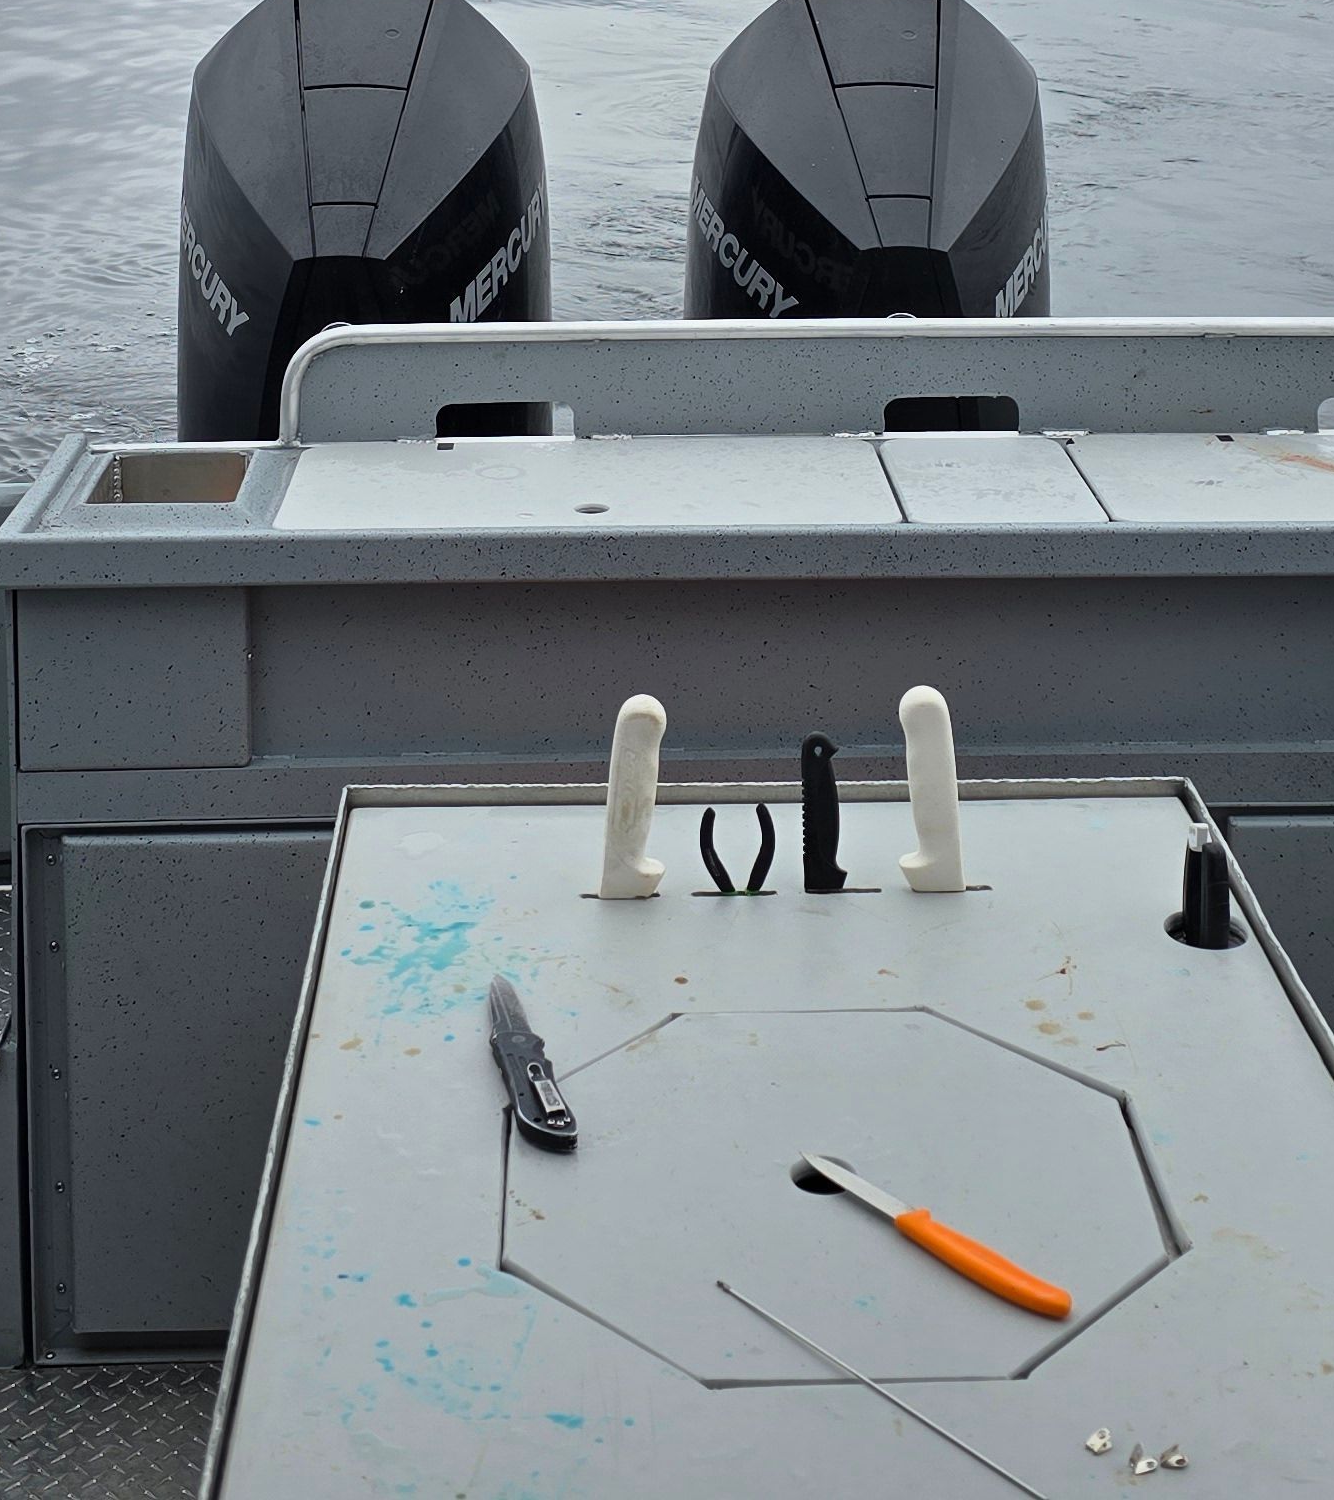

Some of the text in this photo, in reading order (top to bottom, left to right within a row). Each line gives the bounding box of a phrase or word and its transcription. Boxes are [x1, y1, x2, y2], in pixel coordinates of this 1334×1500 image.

[181, 202, 250, 337] ERCURY
[449, 171, 546, 323] MERCURY
[691, 176, 800, 319] MERCURY
[995, 200, 1048, 318] MERCU
